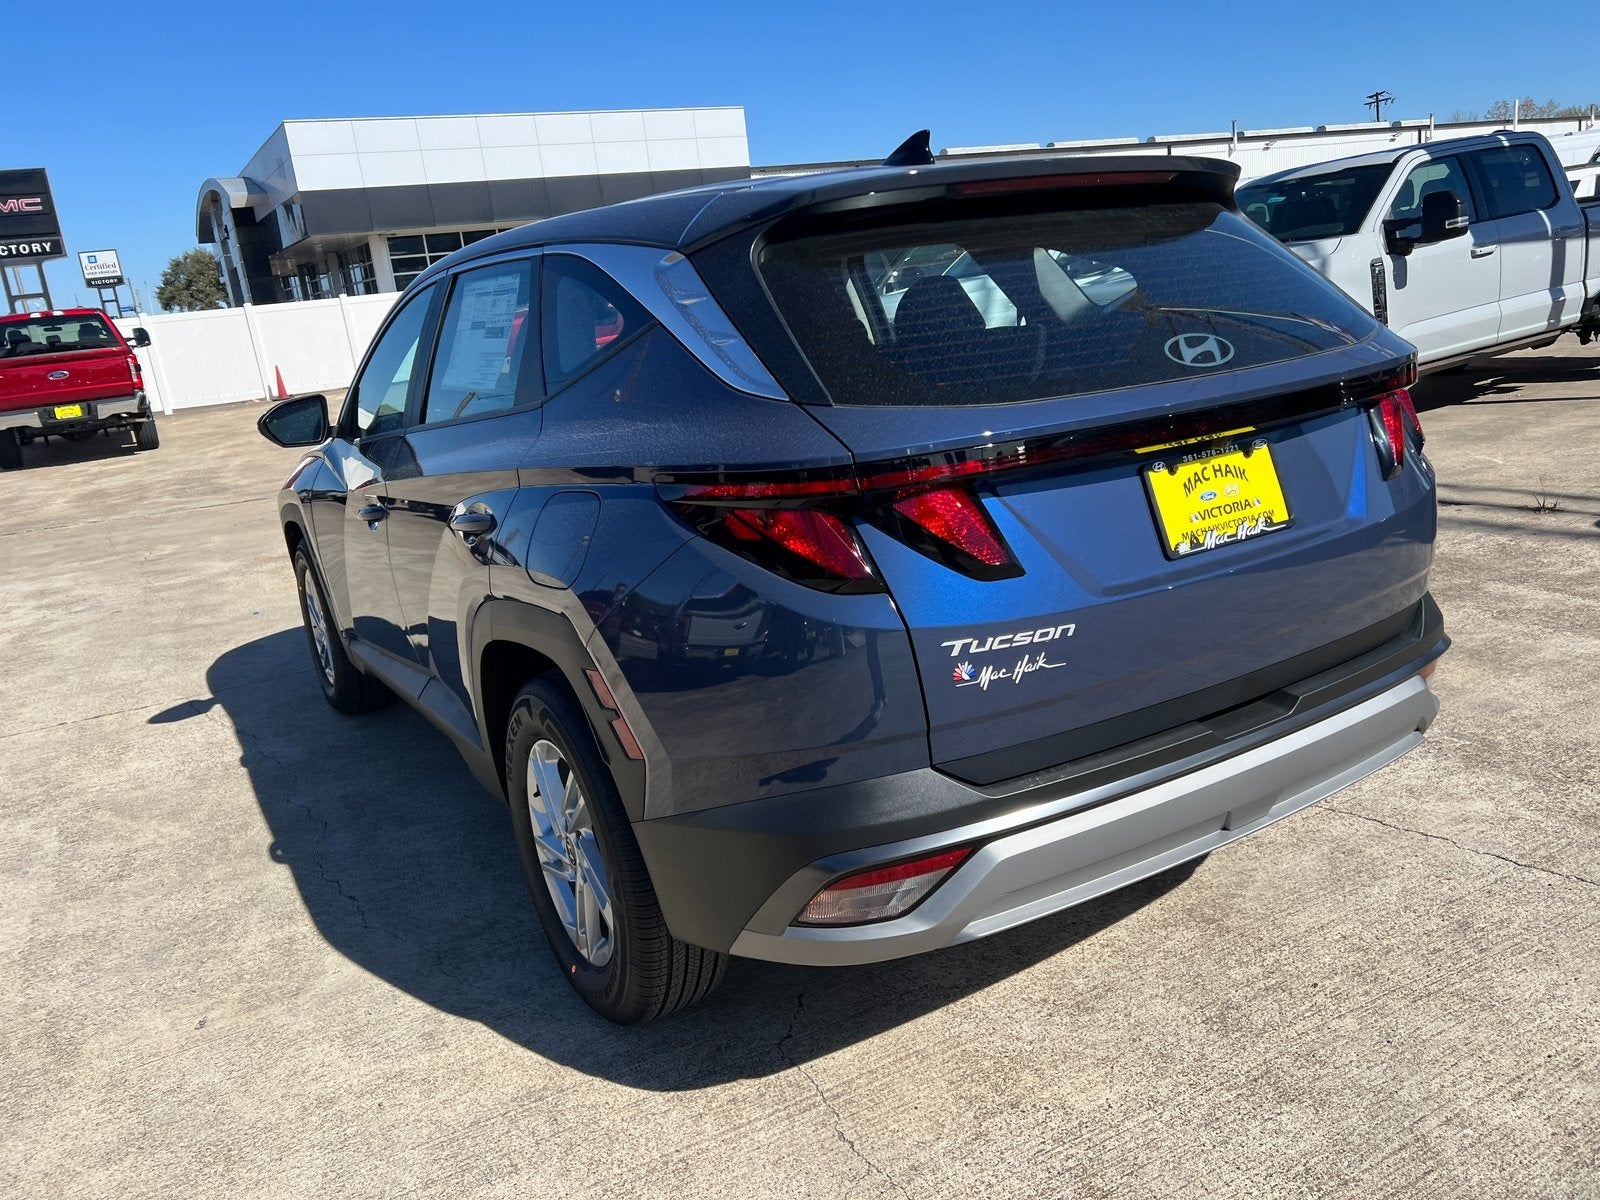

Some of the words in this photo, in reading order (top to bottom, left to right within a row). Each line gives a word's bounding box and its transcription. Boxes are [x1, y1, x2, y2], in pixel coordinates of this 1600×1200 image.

[84, 262, 117, 271] Certified
[1183, 466, 1210, 498] MAC
[1212, 463, 1249, 482] HAIK
[1198, 499, 1252, 520] VICTORIA
[1199, 529, 1237, 549] Mac
[966, 664, 1012, 691] Mac
[1012, 652, 1060, 684] Haik
